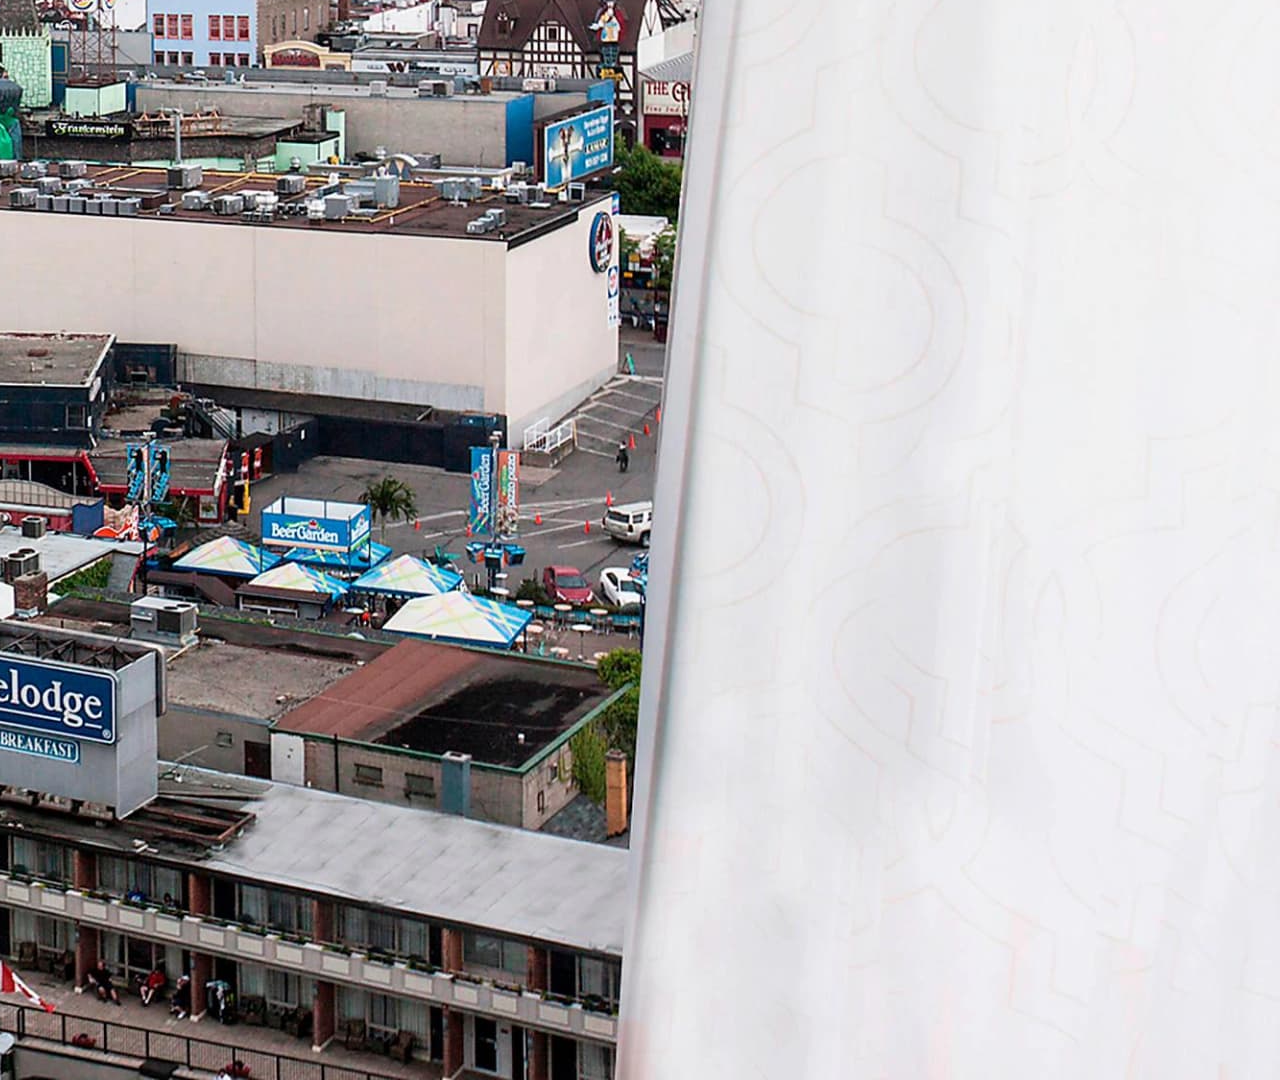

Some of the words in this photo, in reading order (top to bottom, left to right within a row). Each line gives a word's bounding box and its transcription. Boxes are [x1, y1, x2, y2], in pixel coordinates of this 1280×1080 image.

[646, 81, 669, 96] THE
[52, 122, 125, 138] Frankenstein
[0, 730, 75, 759] BREAKFAST
